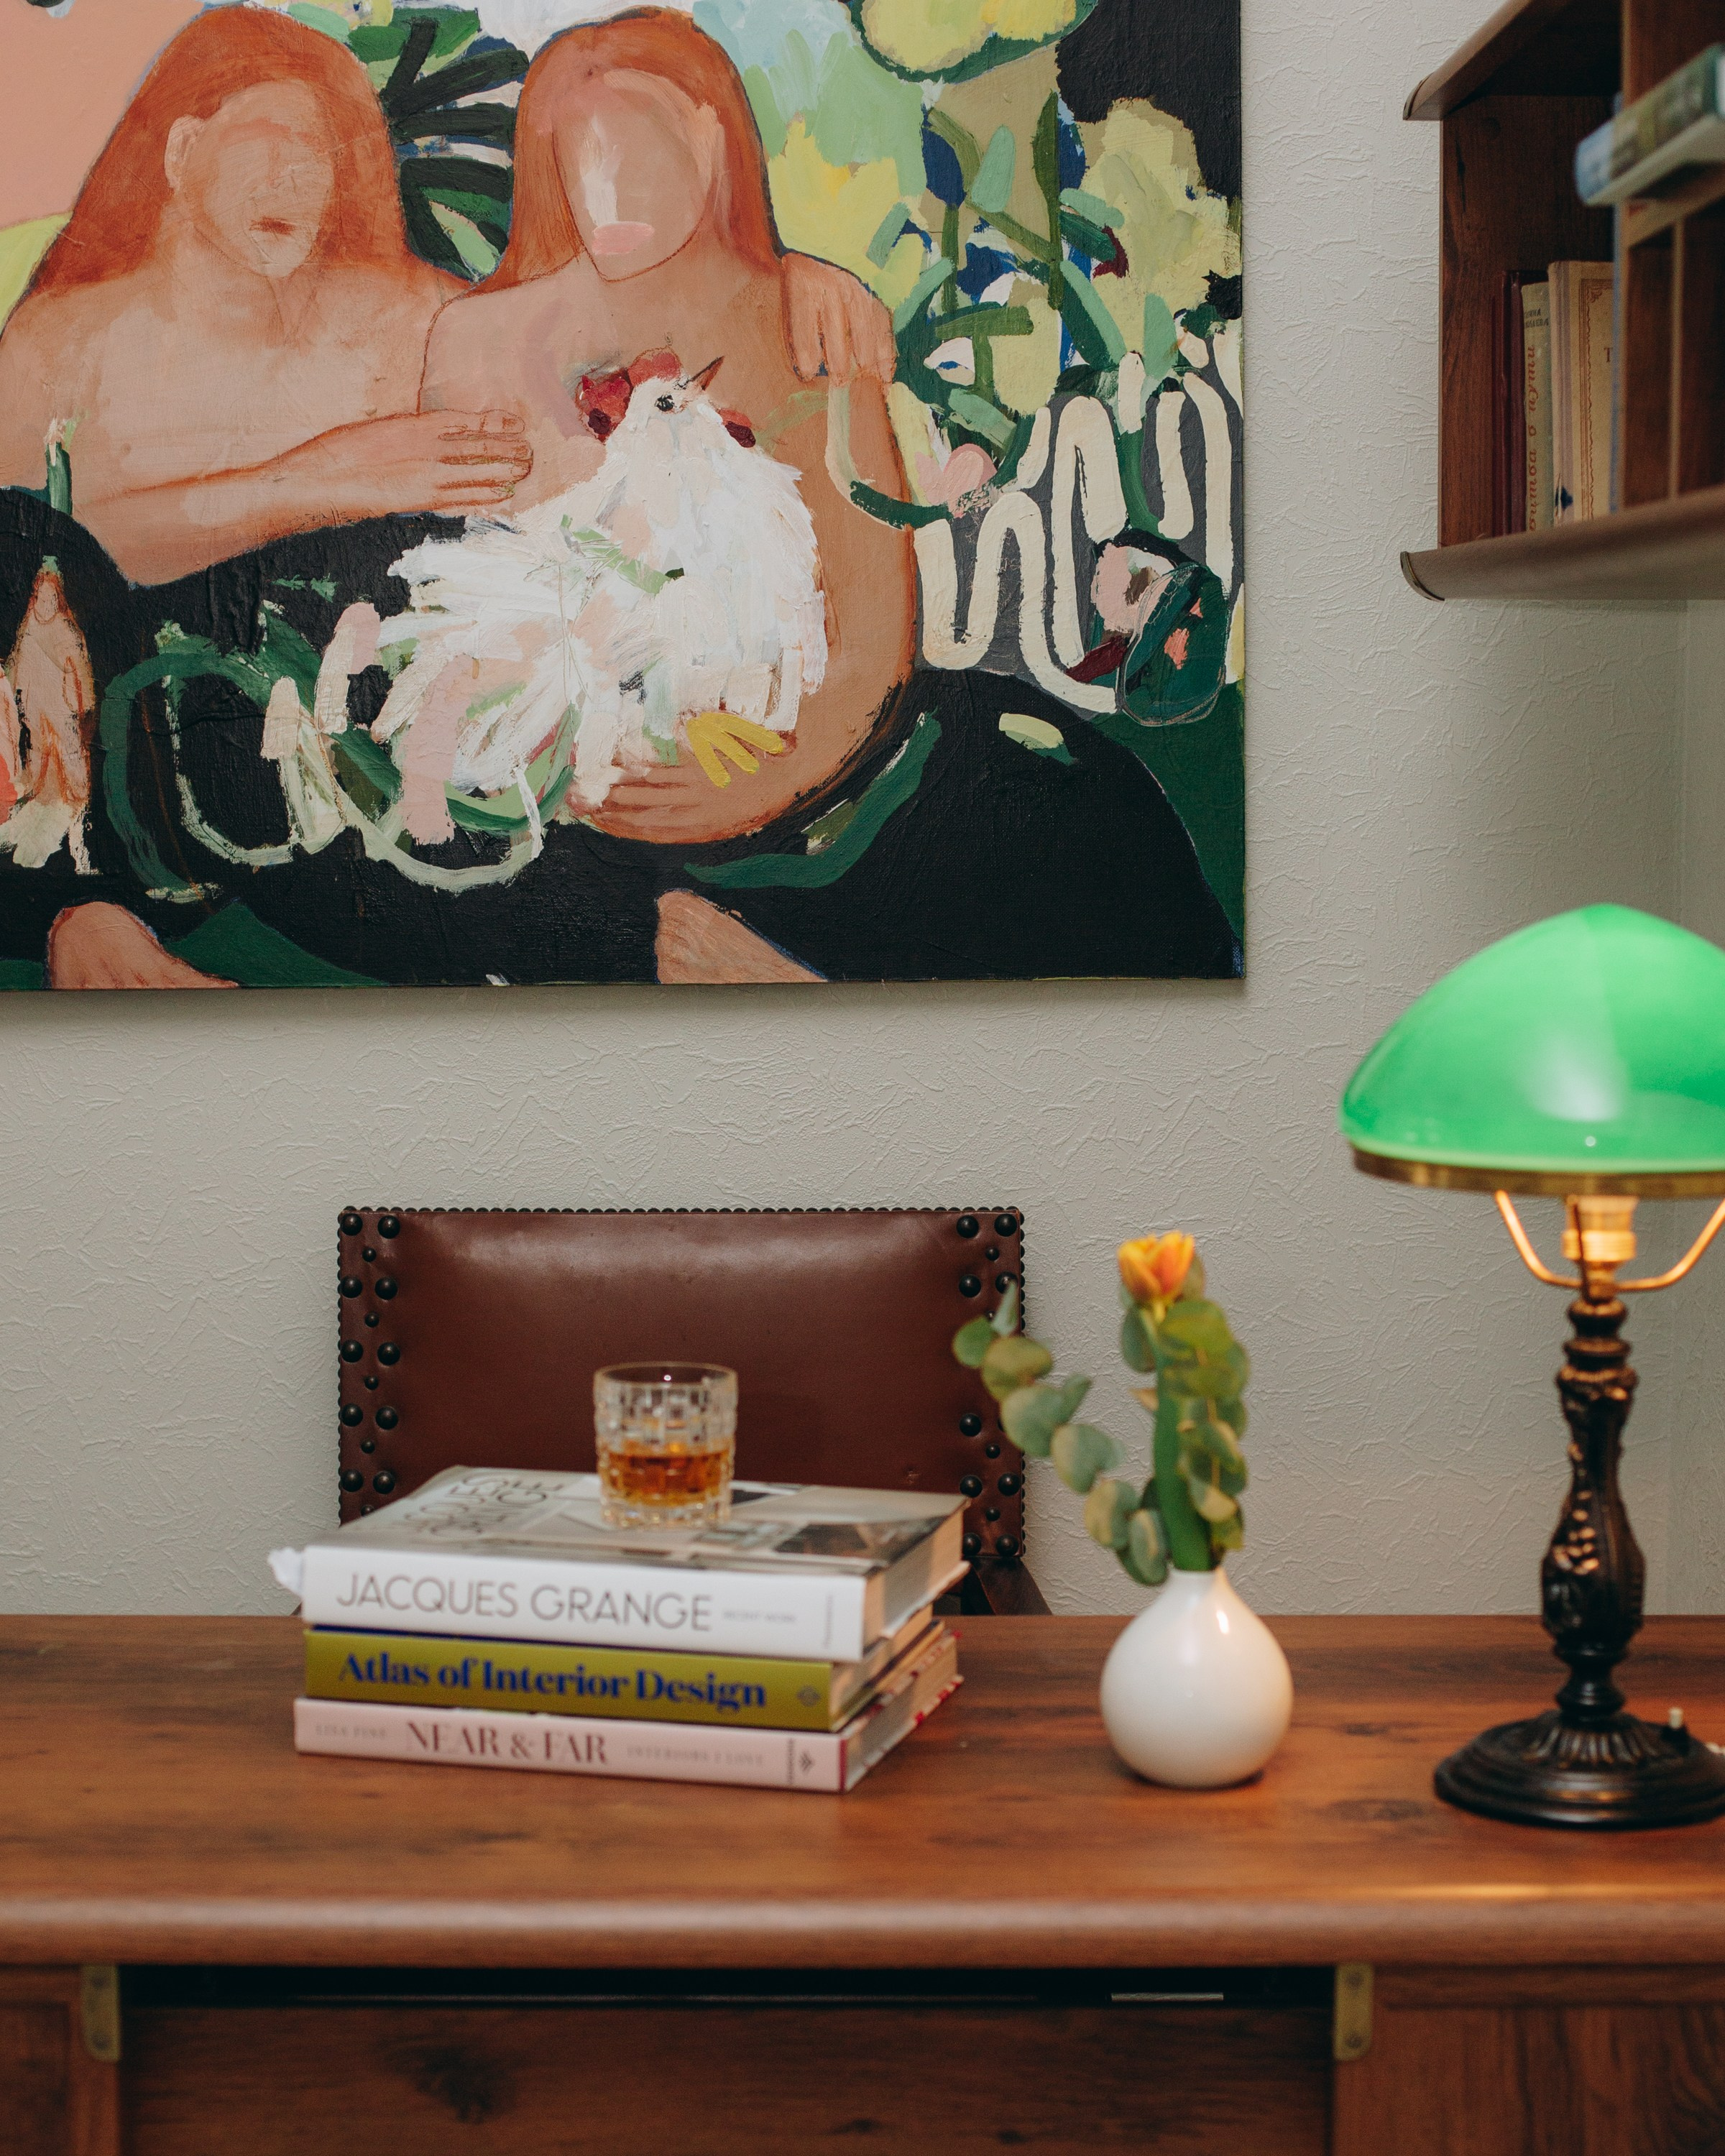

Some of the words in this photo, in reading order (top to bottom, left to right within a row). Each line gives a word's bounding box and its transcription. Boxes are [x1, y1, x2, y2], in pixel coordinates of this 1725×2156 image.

[336, 1573, 519, 1618] JACQUES
[530, 1583, 713, 1632] GRANGE
[338, 1651, 431, 1685] Atlas
[437, 1656, 479, 1689] of
[482, 1659, 631, 1699] Interior
[635, 1668, 767, 1713] Design
[406, 1722, 502, 1756] NEAR
[509, 1731, 536, 1759] &
[542, 1728, 608, 1764] FAR
